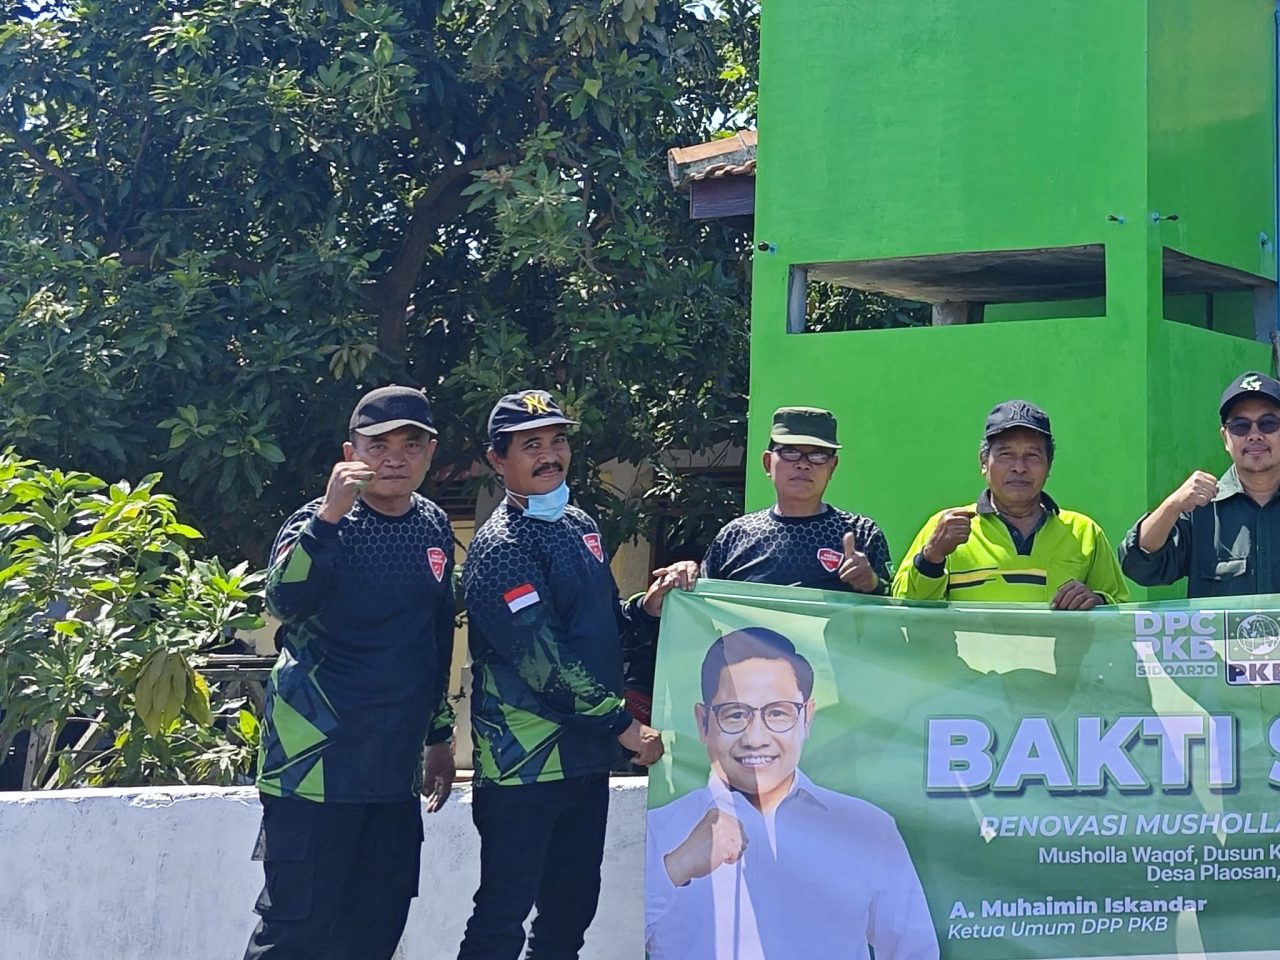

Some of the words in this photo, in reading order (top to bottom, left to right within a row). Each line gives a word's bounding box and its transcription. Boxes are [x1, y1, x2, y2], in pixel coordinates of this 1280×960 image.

[1134, 610, 1217, 636] DPC
[1135, 636, 1218, 661] PKB
[1136, 663, 1217, 676] SIDOARJO
[925, 714, 1238, 792] BAKTI
[980, 814, 1128, 838] RENOVASI
[1038, 845, 1128, 864] Musholla
[1132, 844, 1199, 866] Waqof,
[1203, 844, 1264, 862] Dusun
[1147, 864, 1196, 882] Desa
[949, 901, 975, 919] A.
[981, 896, 1098, 918] Muhaimin
[1104, 895, 1208, 914] Iskandar
[947, 920, 1005, 939] Ketua
[1011, 920, 1076, 937] Umum
[1081, 918, 1124, 934] DPP
[1128, 916, 1169, 932] PKB
